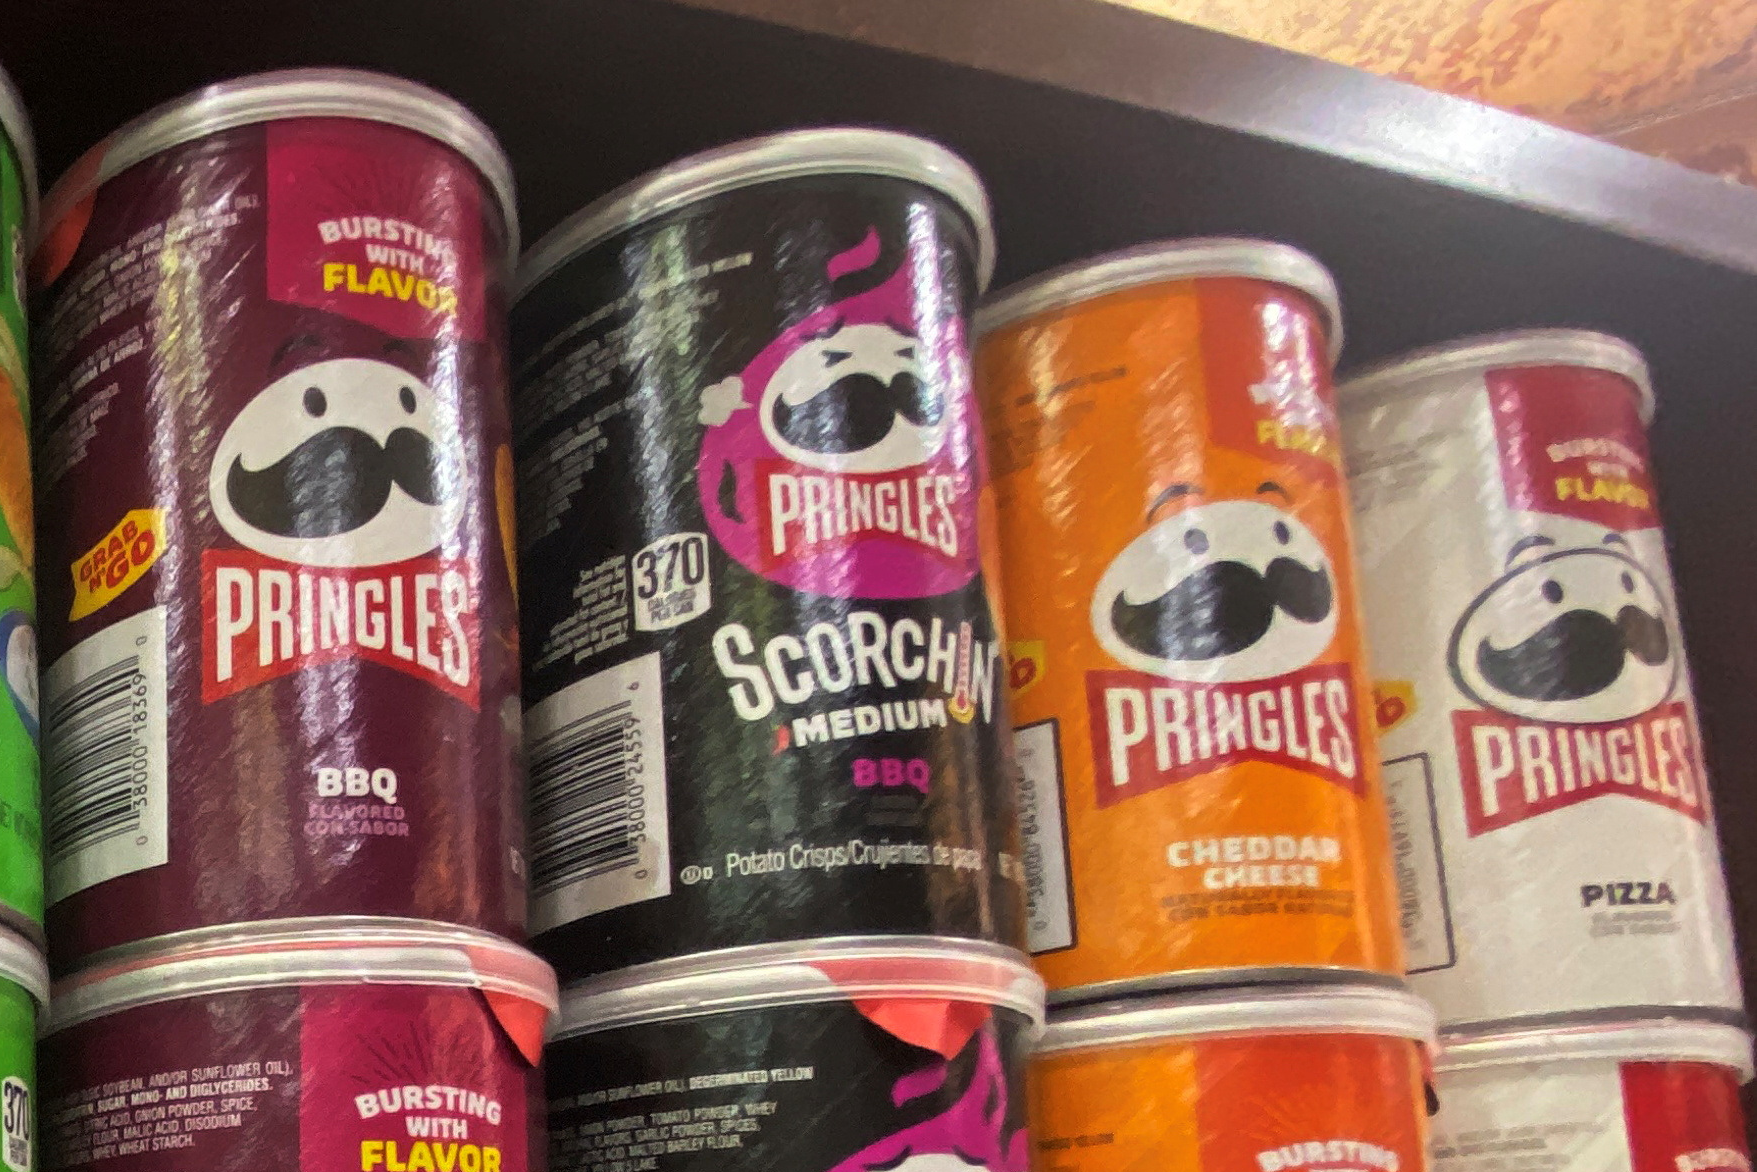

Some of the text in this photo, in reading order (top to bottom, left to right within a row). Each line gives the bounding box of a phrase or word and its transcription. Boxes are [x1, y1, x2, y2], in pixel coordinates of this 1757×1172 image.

[318, 217, 457, 267] BURSTING
[366, 244, 423, 271] WITH
[323, 263, 458, 314] FLAVOR
[769, 474, 957, 557] PRINGLES
[79, 520, 139, 581] GRAB
[106, 529, 155, 589] GO
[636, 537, 704, 598] 370
[216, 567, 470, 687] PRINGLES
[792, 700, 946, 747] MEDIUM
[1104, 680, 1357, 786] PRINGLES
[317, 768, 398, 804] BBQ
[853, 758, 930, 792] BBQ
[1471, 718, 1699, 817] PRINGLES
[726, 851, 785, 877] Potato
[1167, 835, 1341, 867] CHEDDAR
[1202, 866, 1322, 889] CHEESE
[1580, 881, 1676, 909] PIZZA
[166, 1084, 188, 1099] AND
[192, 1062, 260, 1082] SUNFLOWER
[354, 1085, 502, 1126] BURSTING
[406, 1116, 468, 1139] WITH
